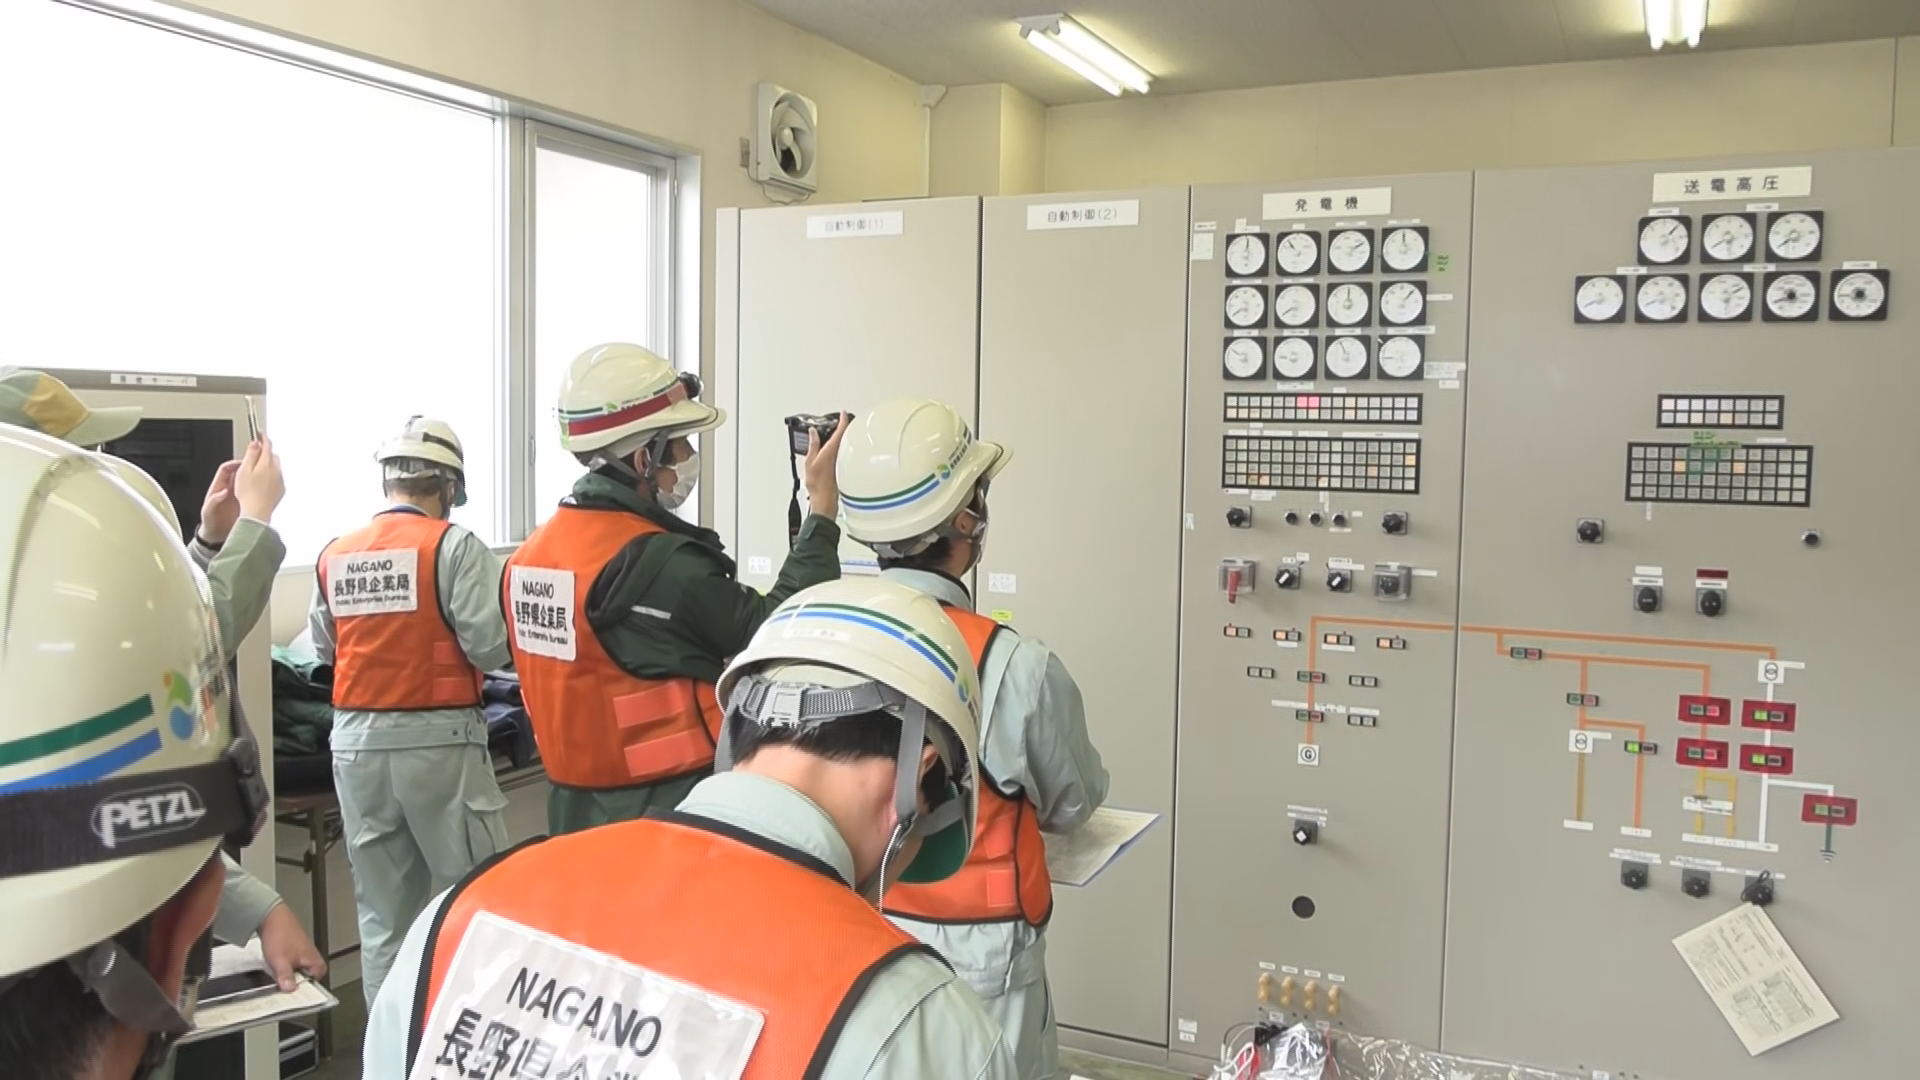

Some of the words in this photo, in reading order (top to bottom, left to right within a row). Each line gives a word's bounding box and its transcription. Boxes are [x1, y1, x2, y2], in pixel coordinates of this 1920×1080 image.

[1684, 174, 1780, 195] 送電高圧
[1295, 196, 1359, 213] 発電機
[346, 559, 393, 574] NAGANO
[335, 573, 410, 597] 長野県企業局
[522, 580, 555, 599] NAGANO
[1304, 749, 1313, 760] G
[101, 790, 207, 848] PETZL
[505, 966, 662, 1058] NAGANO
